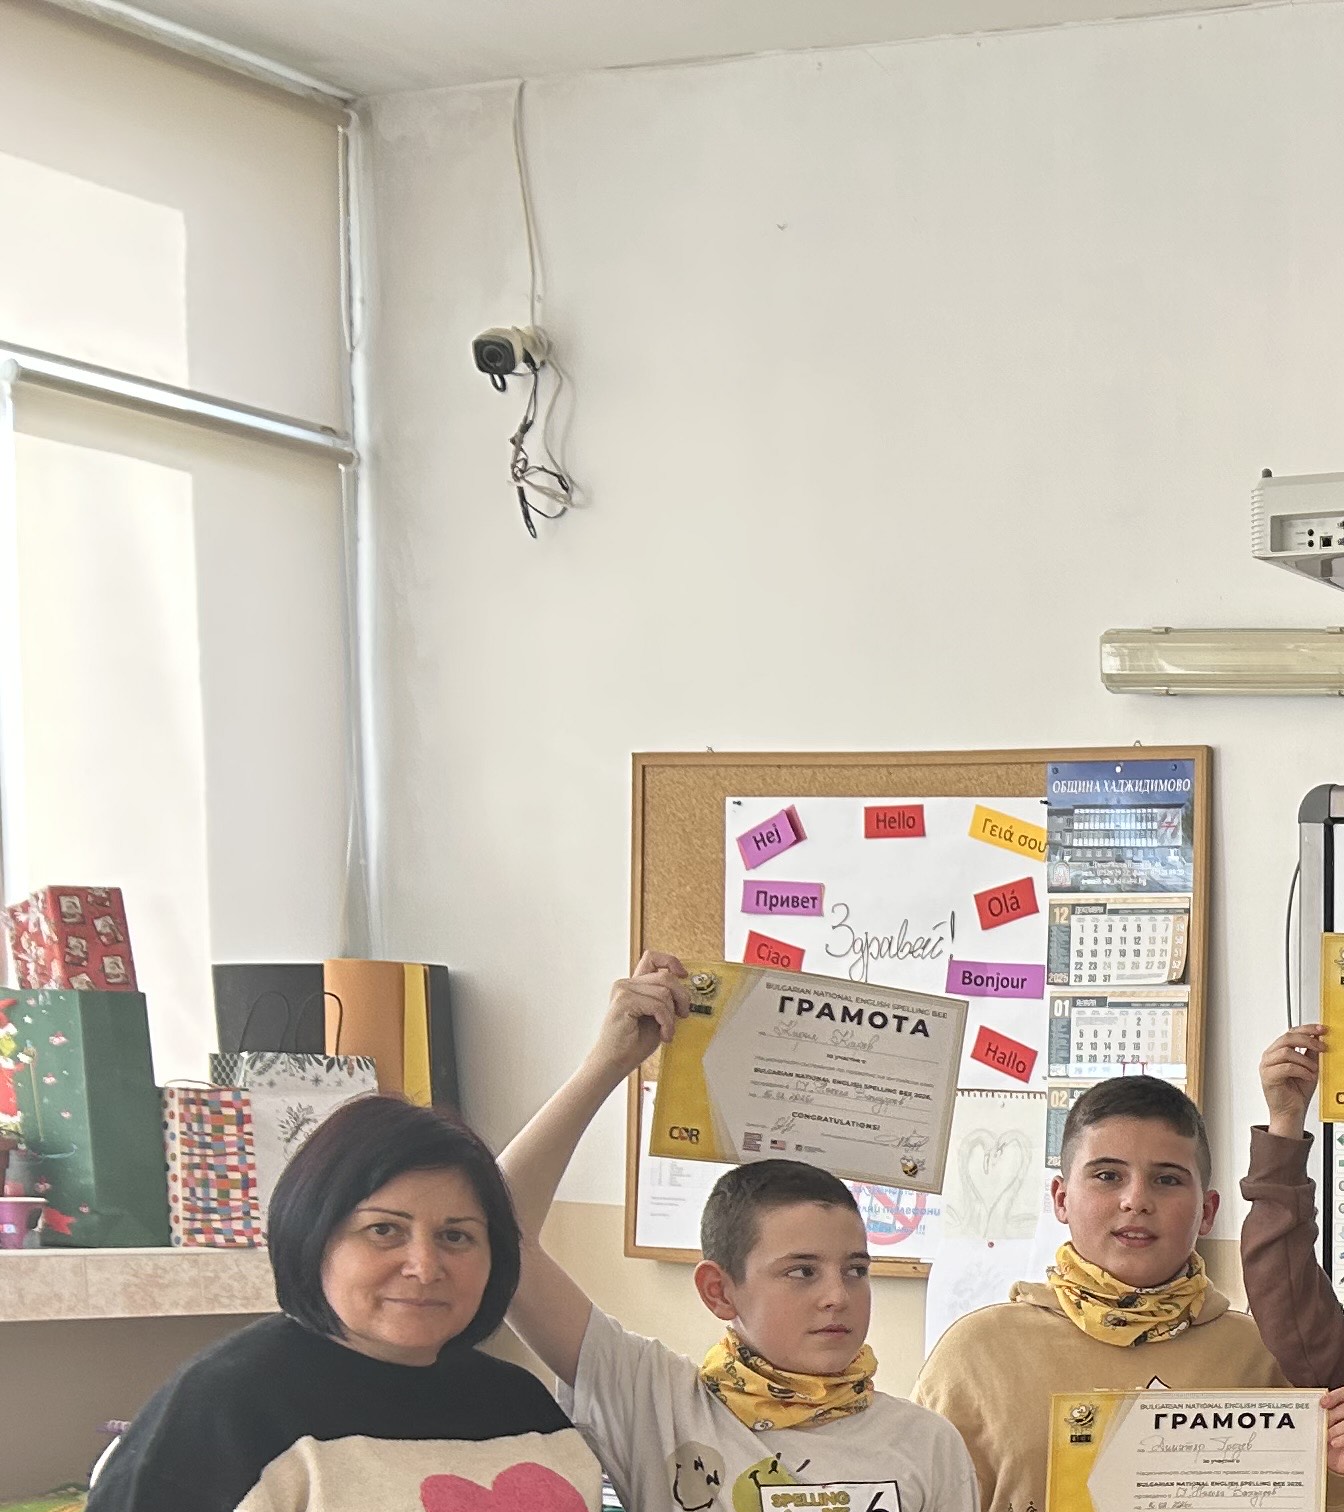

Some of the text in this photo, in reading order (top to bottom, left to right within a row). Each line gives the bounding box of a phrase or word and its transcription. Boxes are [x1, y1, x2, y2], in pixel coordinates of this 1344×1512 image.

[1053, 779, 1191, 794] ОБЩИНА ХАДЖИДИМОВО
[875, 811, 916, 829] Hello
[753, 824, 782, 850] Hej
[982, 818, 1047, 854] Γειά σου
[755, 890, 818, 911] Привет
[987, 889, 1021, 917] Olá
[1054, 907, 1068, 923] 12
[757, 943, 791, 969] Ciao
[962, 970, 1027, 990] Bonjour
[778, 995, 930, 1038] ГРАМОТА
[1054, 1000, 1069, 1016] 01
[985, 1042, 1026, 1074] Hallo
[1051, 1091, 1067, 1107] 02
[792, 1111, 880, 1131] CONGRATULATIONS!
[1154, 1412, 1295, 1430] ГРАМОТА
[771, 1490, 850, 1508] SPELLING
